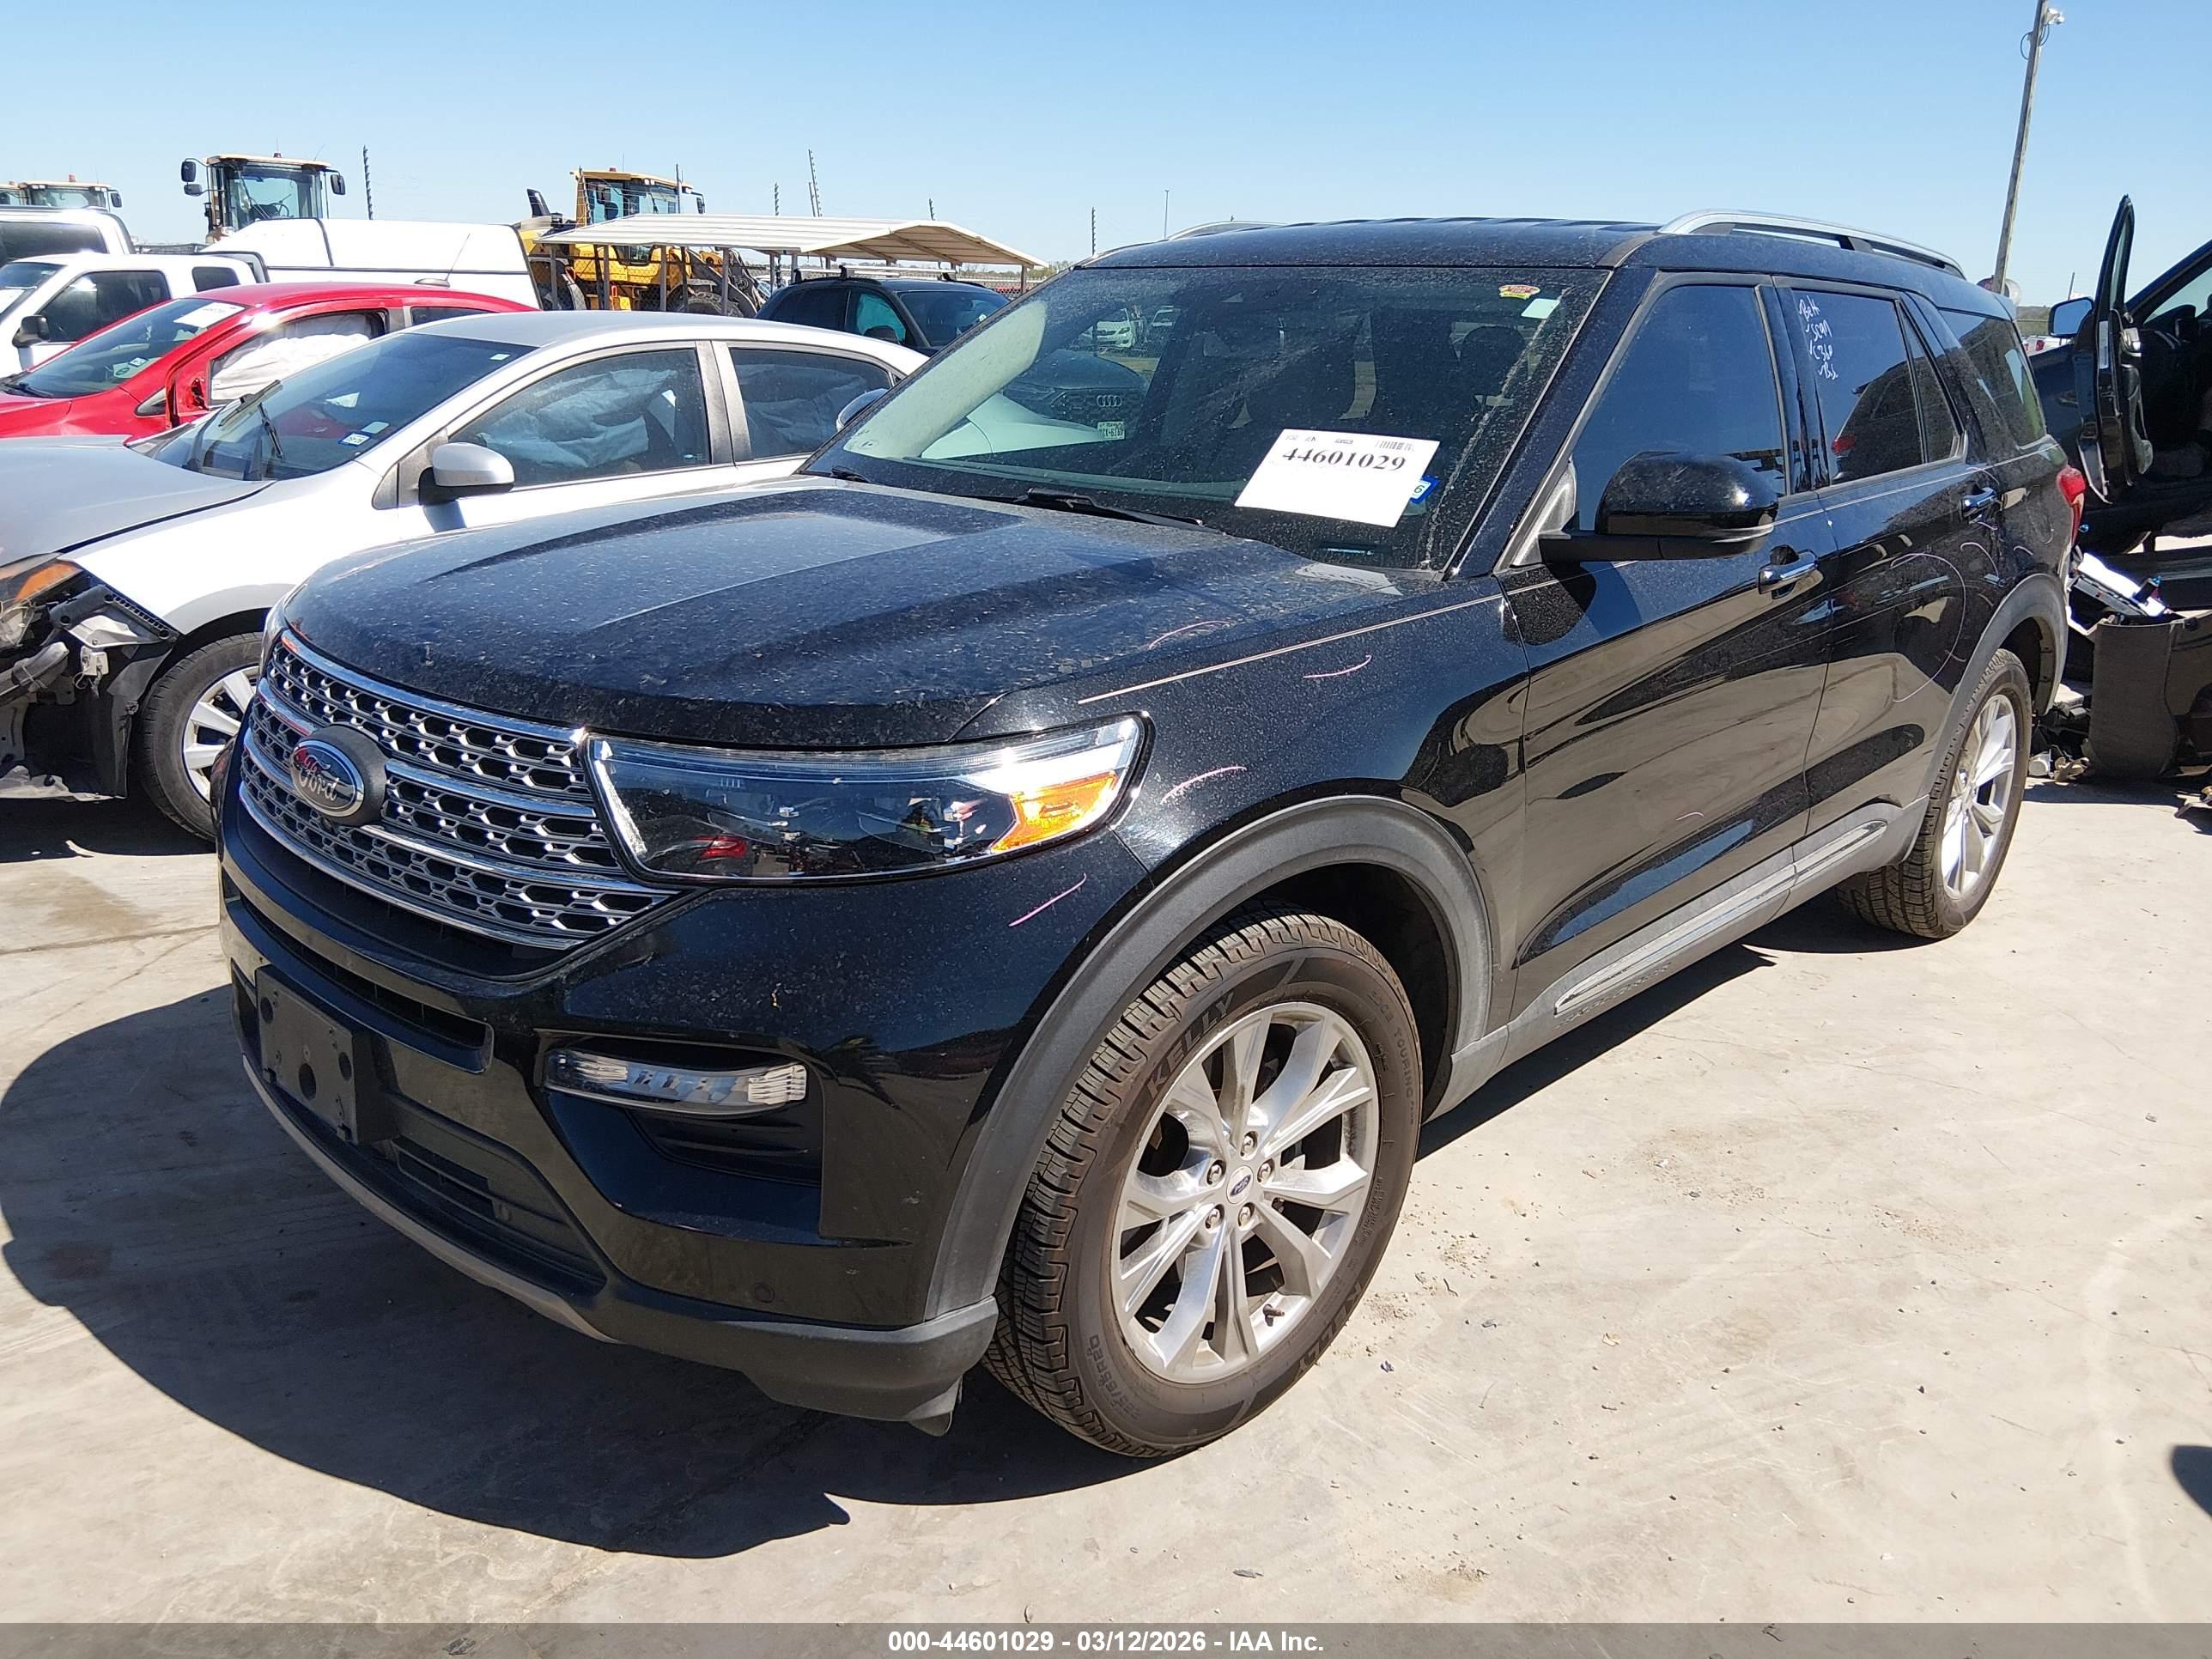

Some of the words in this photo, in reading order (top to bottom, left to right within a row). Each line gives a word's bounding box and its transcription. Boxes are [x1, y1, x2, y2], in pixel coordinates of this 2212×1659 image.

[1283, 447, 1407, 471] 44601029
[298, 754, 340, 801] Ford
[1146, 992, 1235, 1099] KELLY
[1394, 1028, 1415, 1099] TOURING
